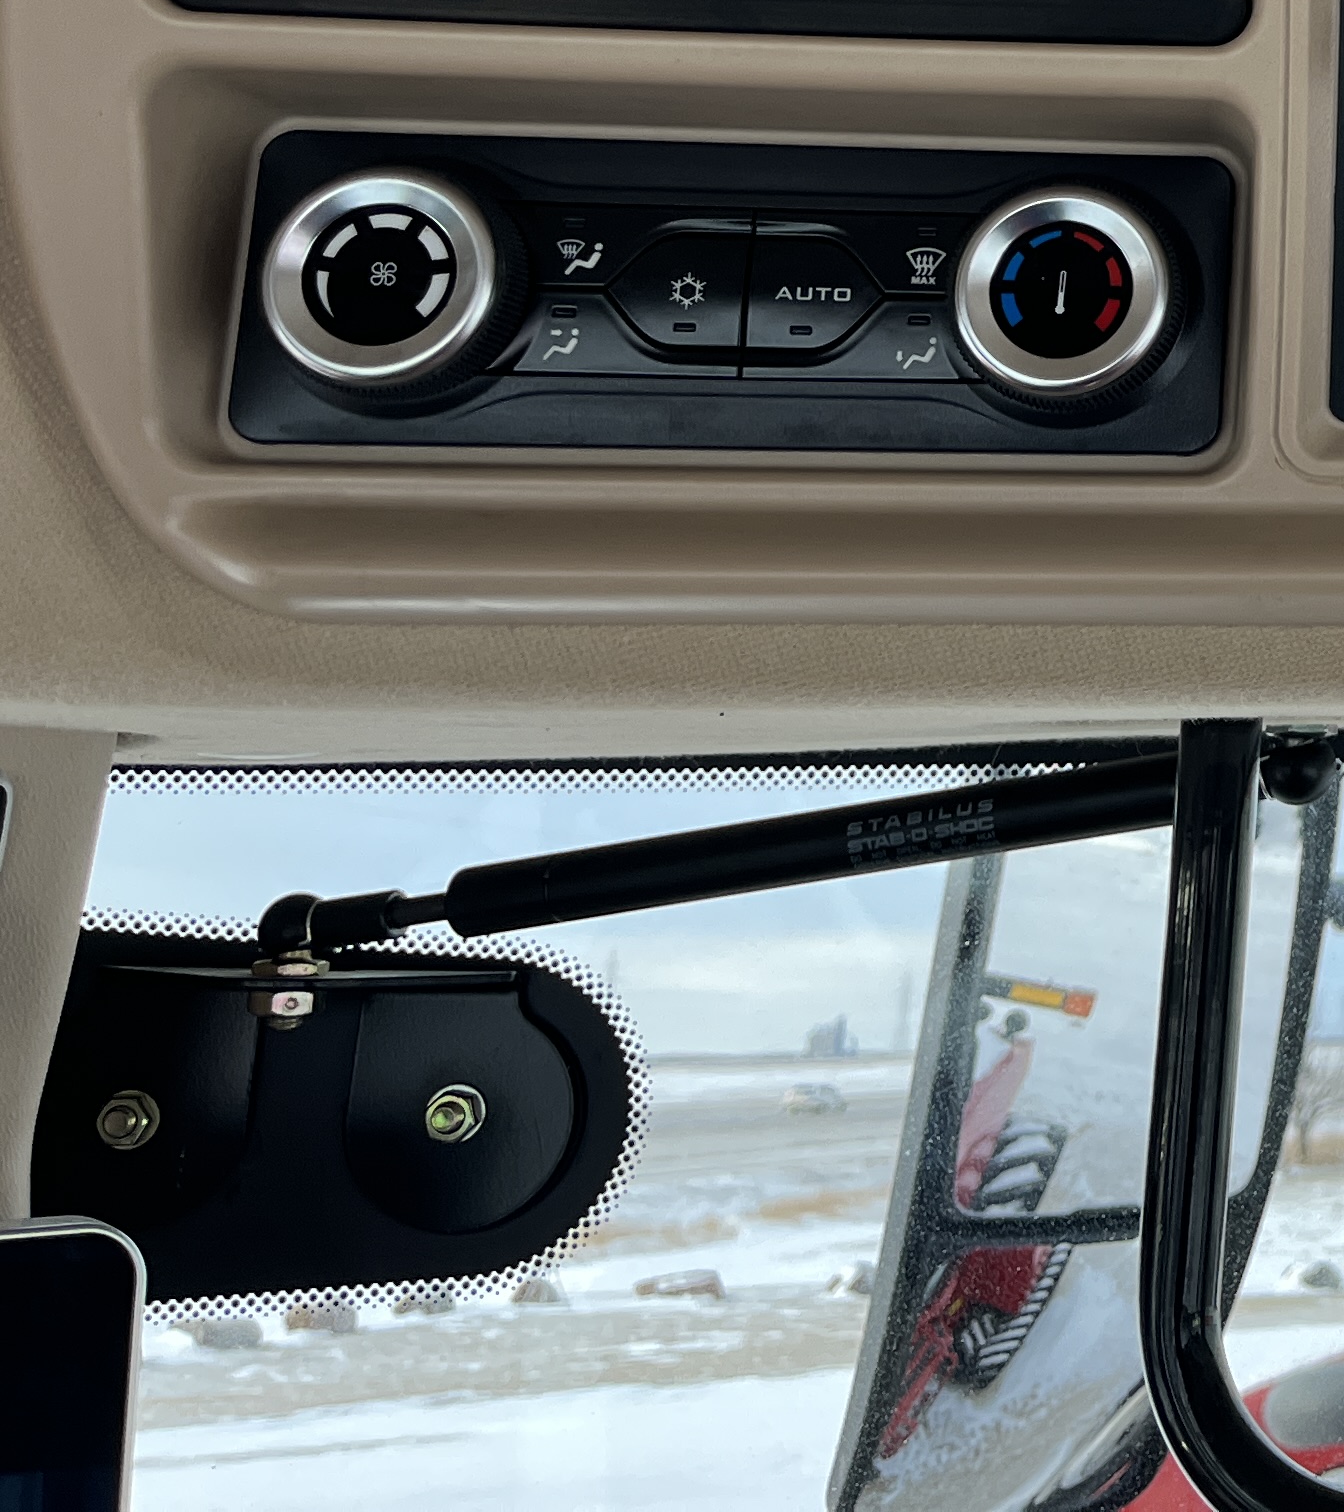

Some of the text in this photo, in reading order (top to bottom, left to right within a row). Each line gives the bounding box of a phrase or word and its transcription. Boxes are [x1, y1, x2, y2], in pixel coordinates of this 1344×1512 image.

[910, 274, 937, 285] MAX
[774, 286, 852, 302] AUTO
[847, 798, 995, 837] STABILUS
